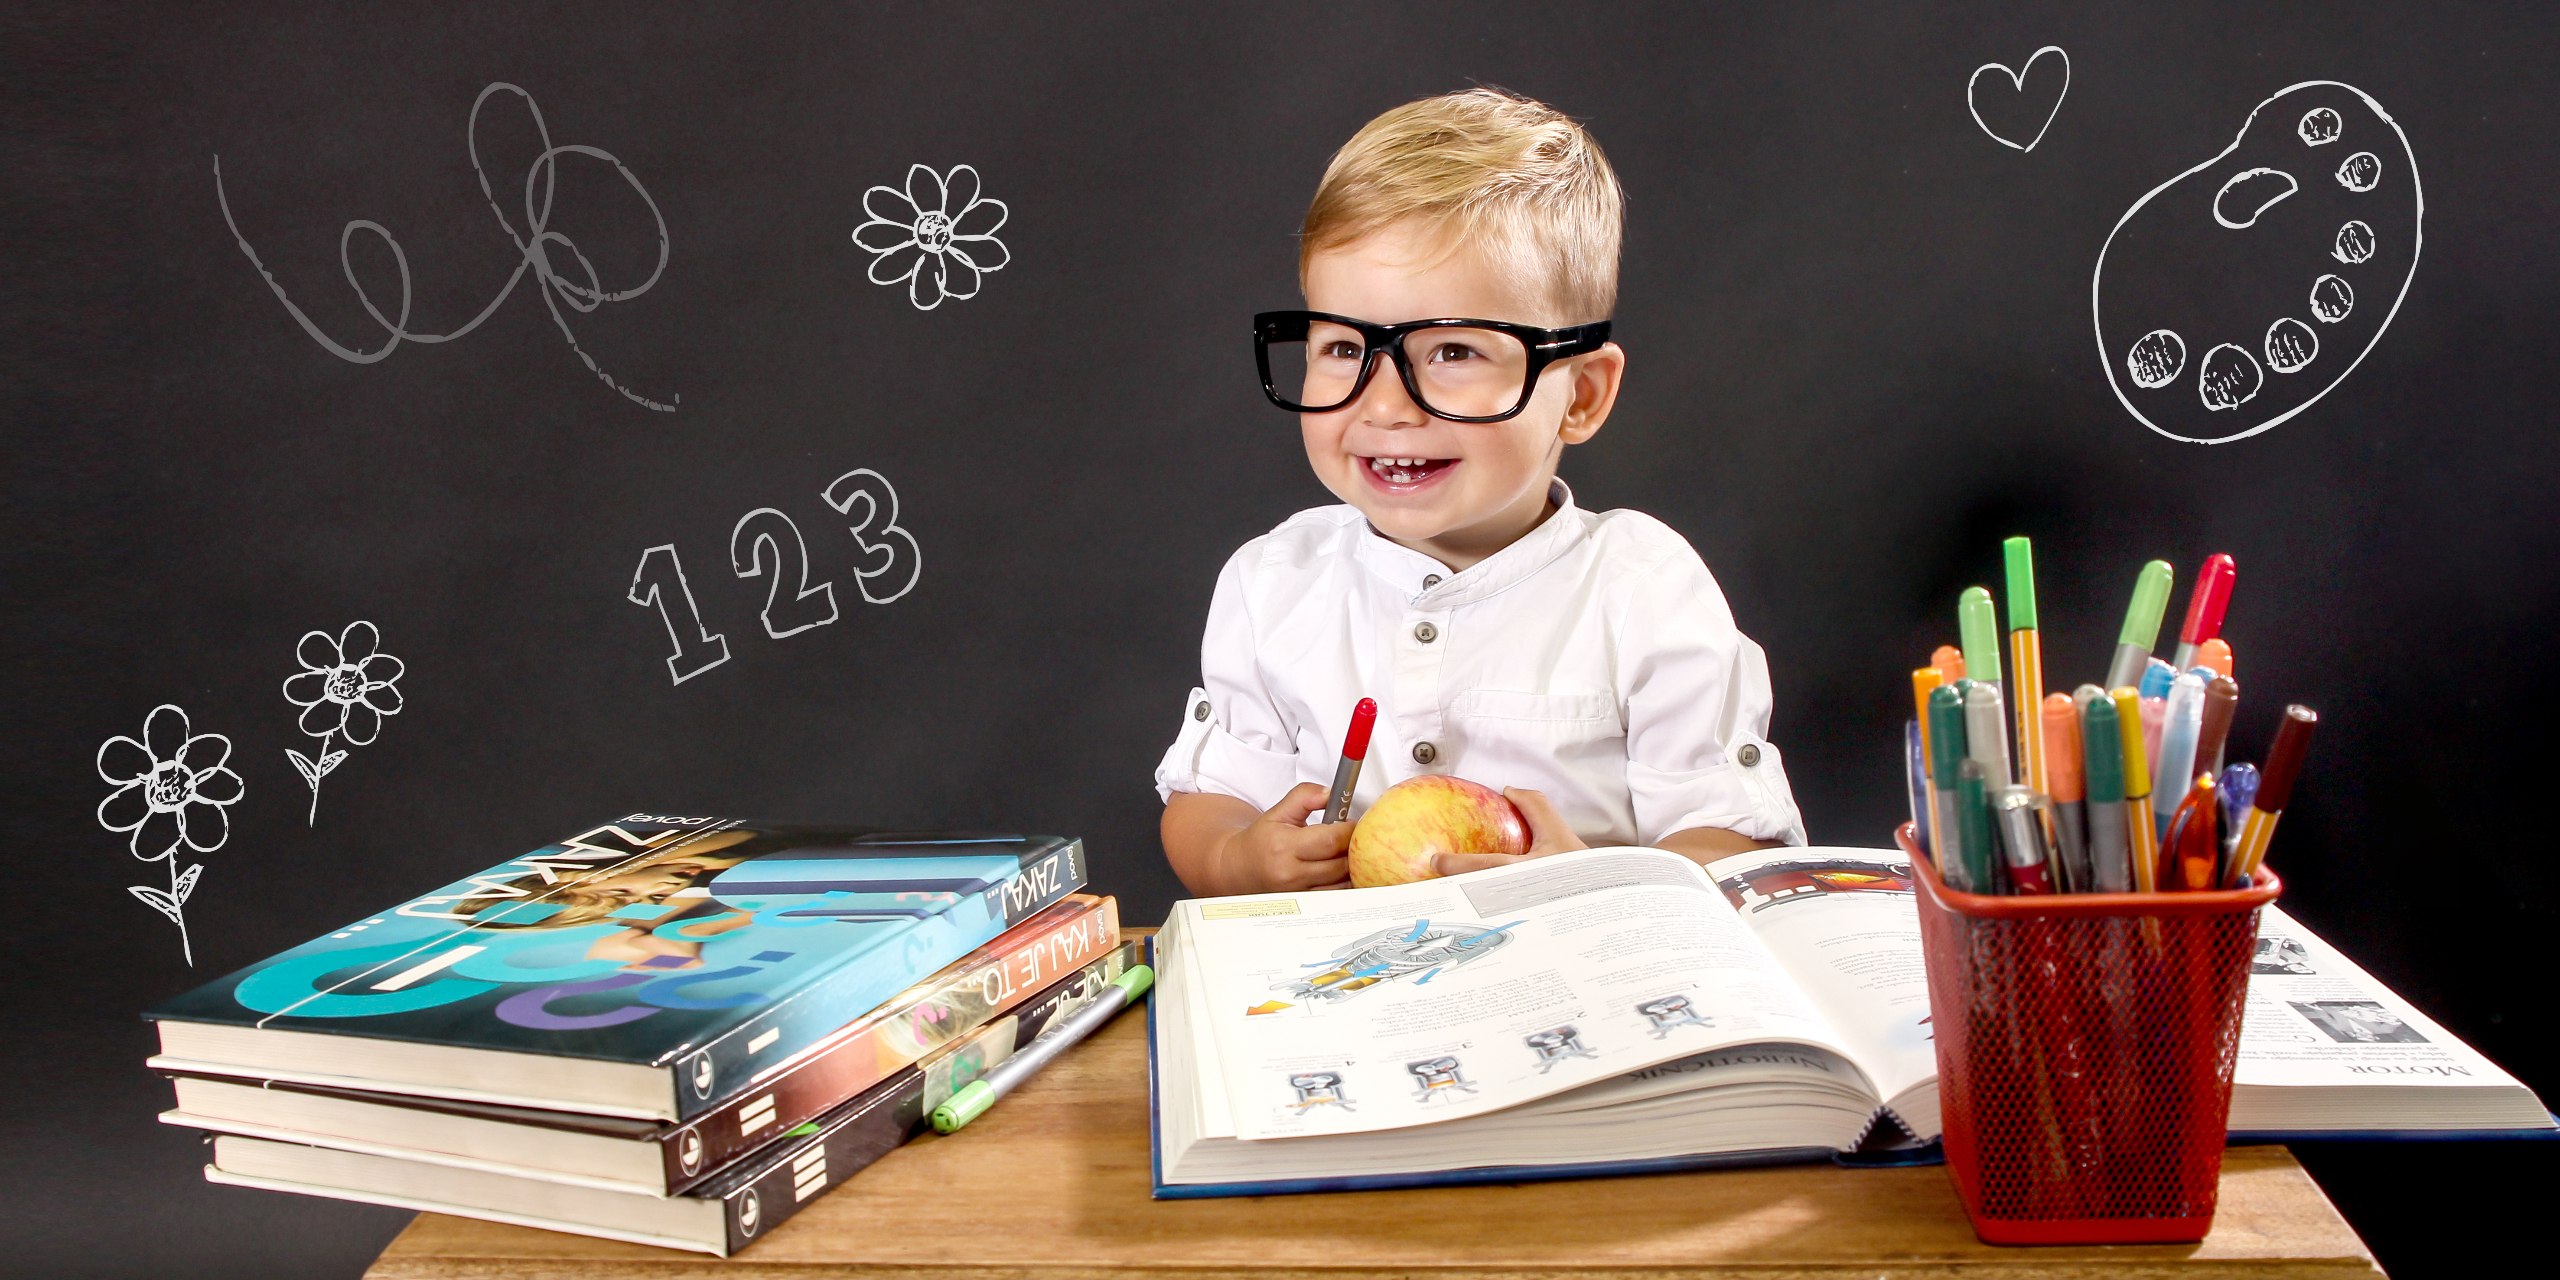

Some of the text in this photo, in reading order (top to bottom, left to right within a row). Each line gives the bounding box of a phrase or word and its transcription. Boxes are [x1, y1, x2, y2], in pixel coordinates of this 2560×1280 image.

[615, 813, 714, 826] povej
[1065, 845, 1078, 881] povej
[1050, 918, 1090, 971] KAJ
[1096, 909, 1107, 945] povej
[1018, 943, 1046, 988] JE
